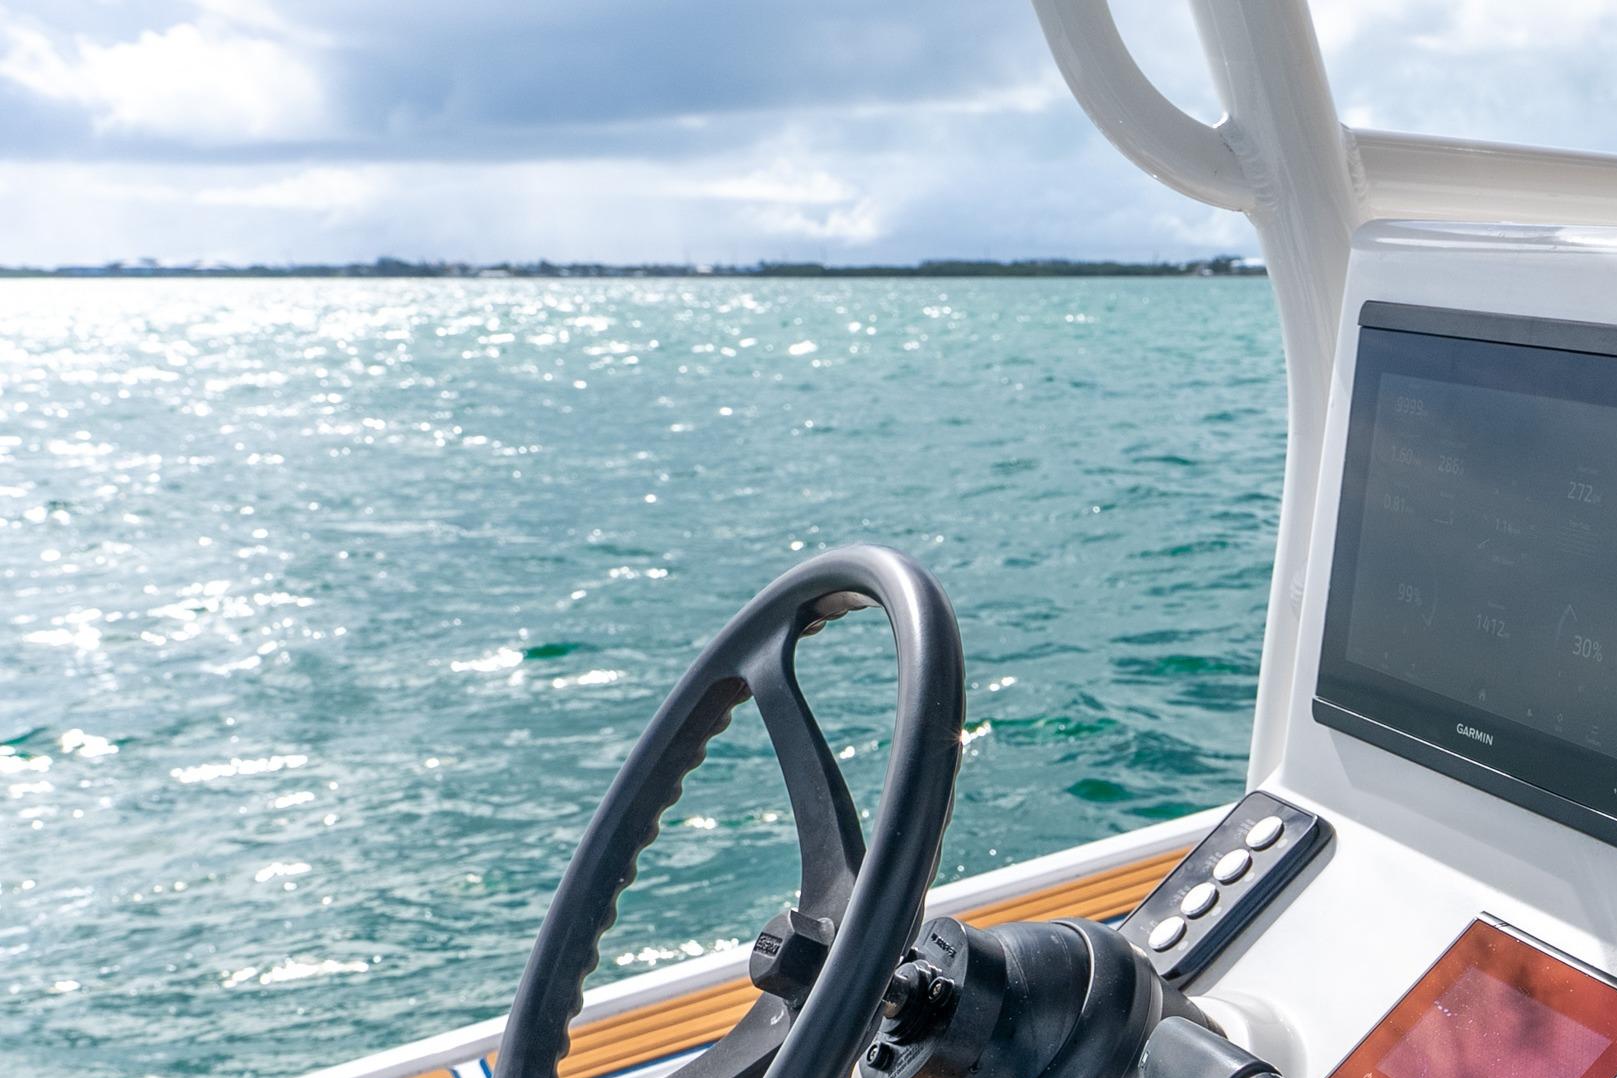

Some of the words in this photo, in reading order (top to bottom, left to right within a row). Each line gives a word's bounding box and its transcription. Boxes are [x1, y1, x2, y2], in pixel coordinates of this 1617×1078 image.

[1567, 480, 1594, 504] 272
[1572, 635, 1604, 663] 30%
[1456, 722, 1494, 747] GARMIN
